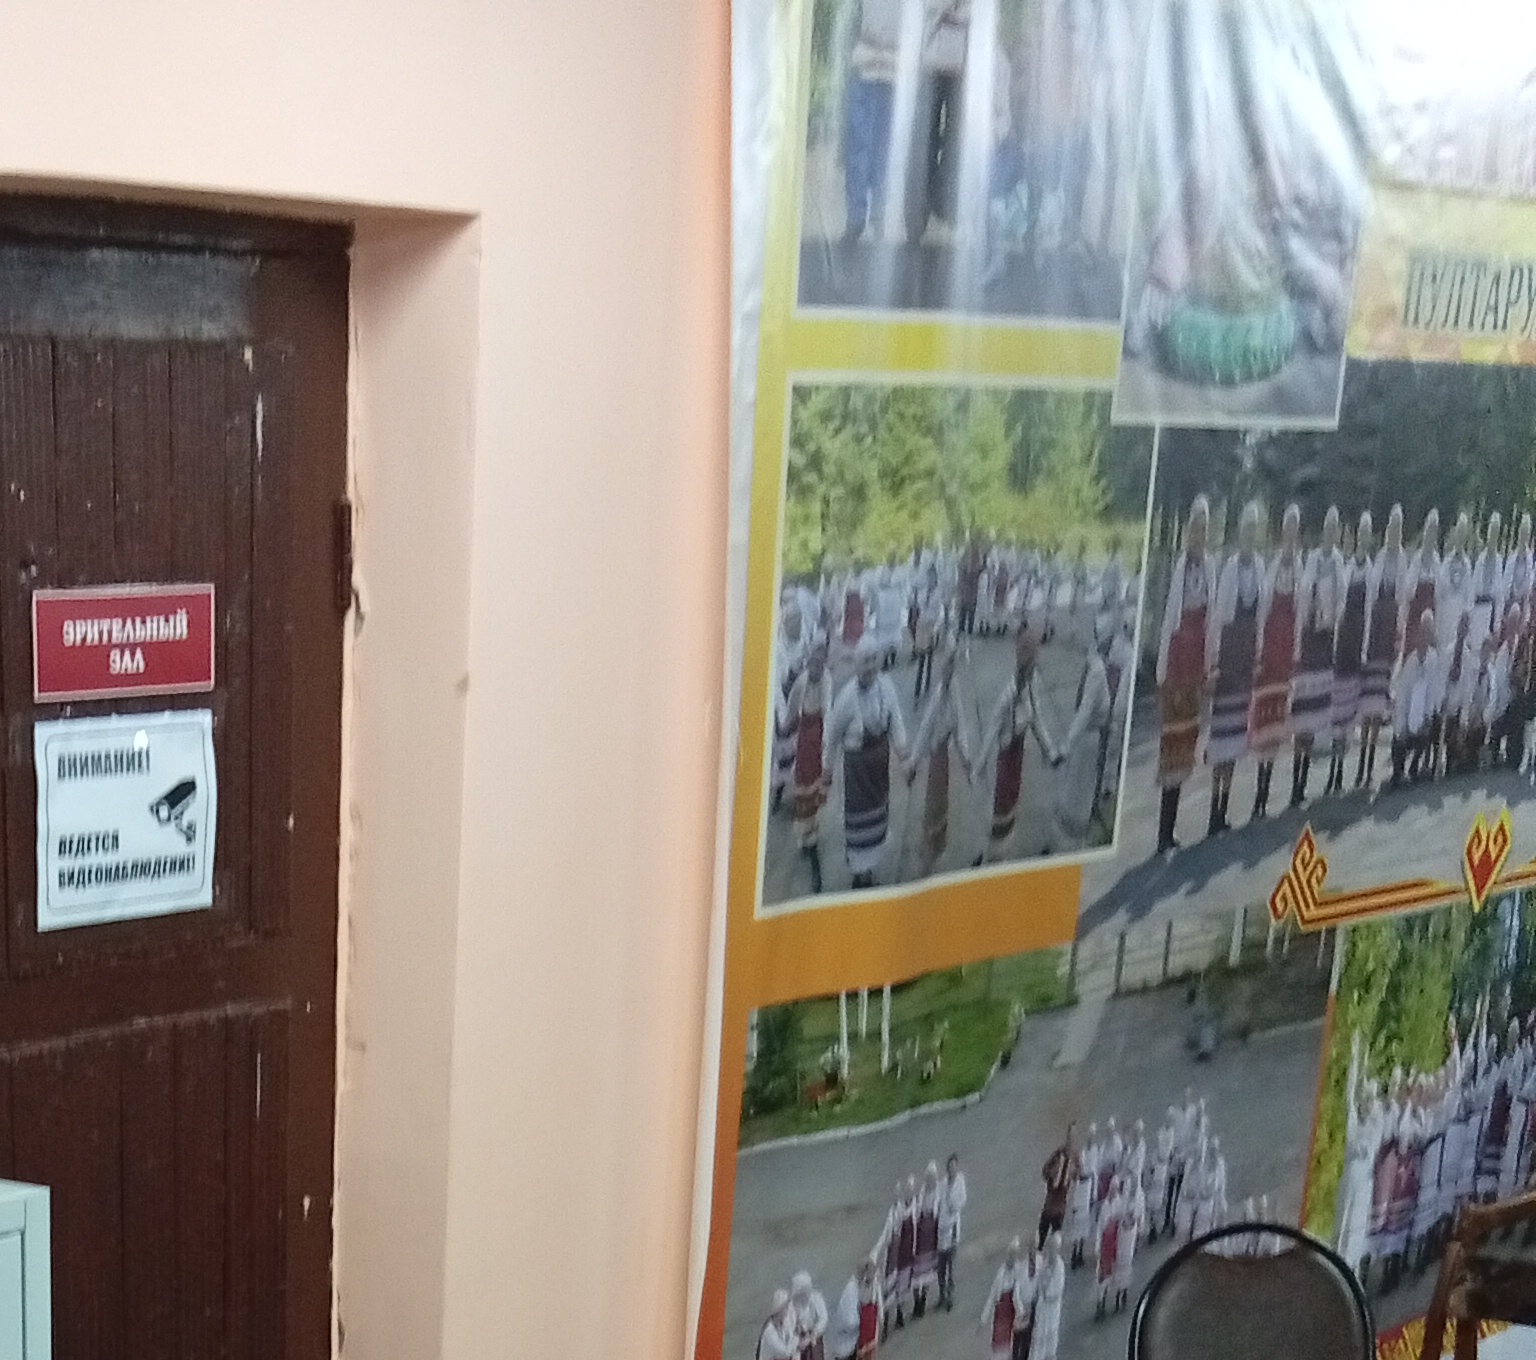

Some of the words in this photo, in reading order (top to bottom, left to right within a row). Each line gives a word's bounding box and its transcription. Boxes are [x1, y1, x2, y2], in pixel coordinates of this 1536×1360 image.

[63, 608, 189, 648] ЗРИТЕЛЬНЫЙ
[109, 646, 145, 675] ЗАЛ
[57, 747, 150, 782] ВНИМАНИЕ!
[58, 829, 119, 859] ВЕДЕТСЯ
[58, 853, 196, 892] ВИДЕОНАБЛЮДЕНИЕ!
